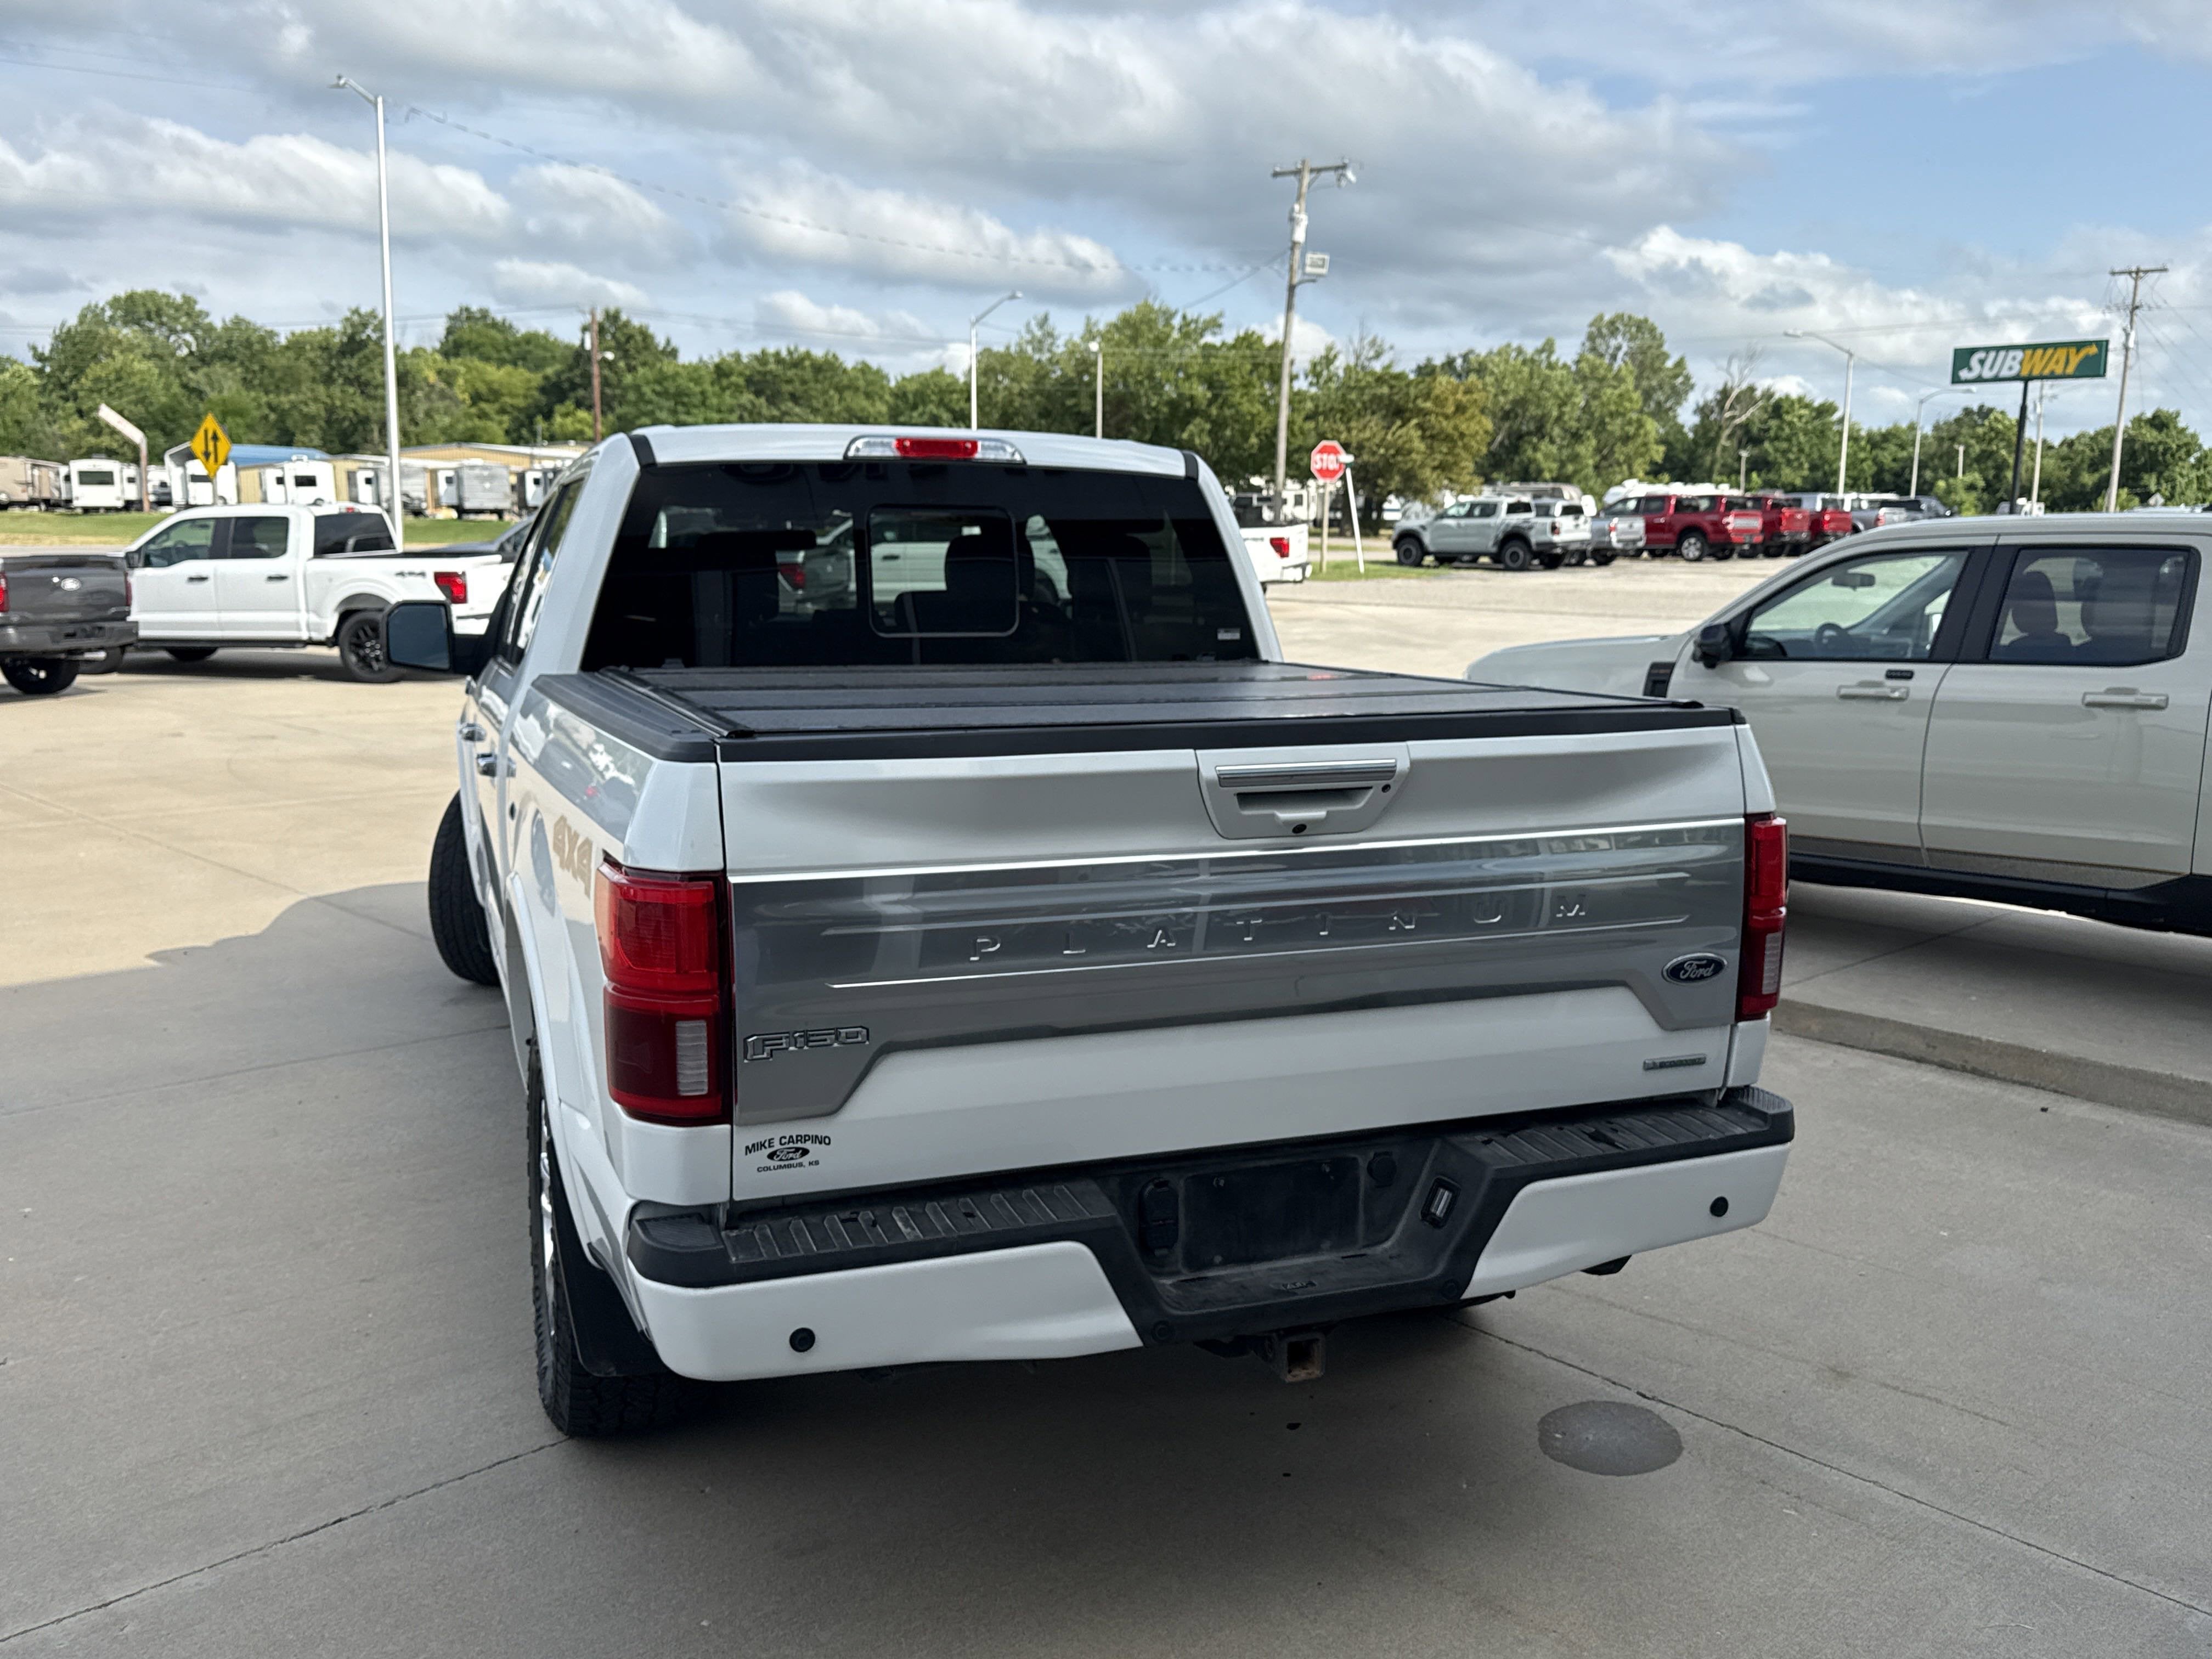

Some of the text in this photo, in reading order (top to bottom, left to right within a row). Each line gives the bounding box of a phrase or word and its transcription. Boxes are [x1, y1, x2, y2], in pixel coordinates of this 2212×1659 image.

[1958, 343, 2098, 381] SUBWAY
[969, 893, 1587, 962] PLATINUM
[745, 1134, 831, 1156] MIKE CARPINO
[757, 1161, 805, 1172] COLUMBUS,
